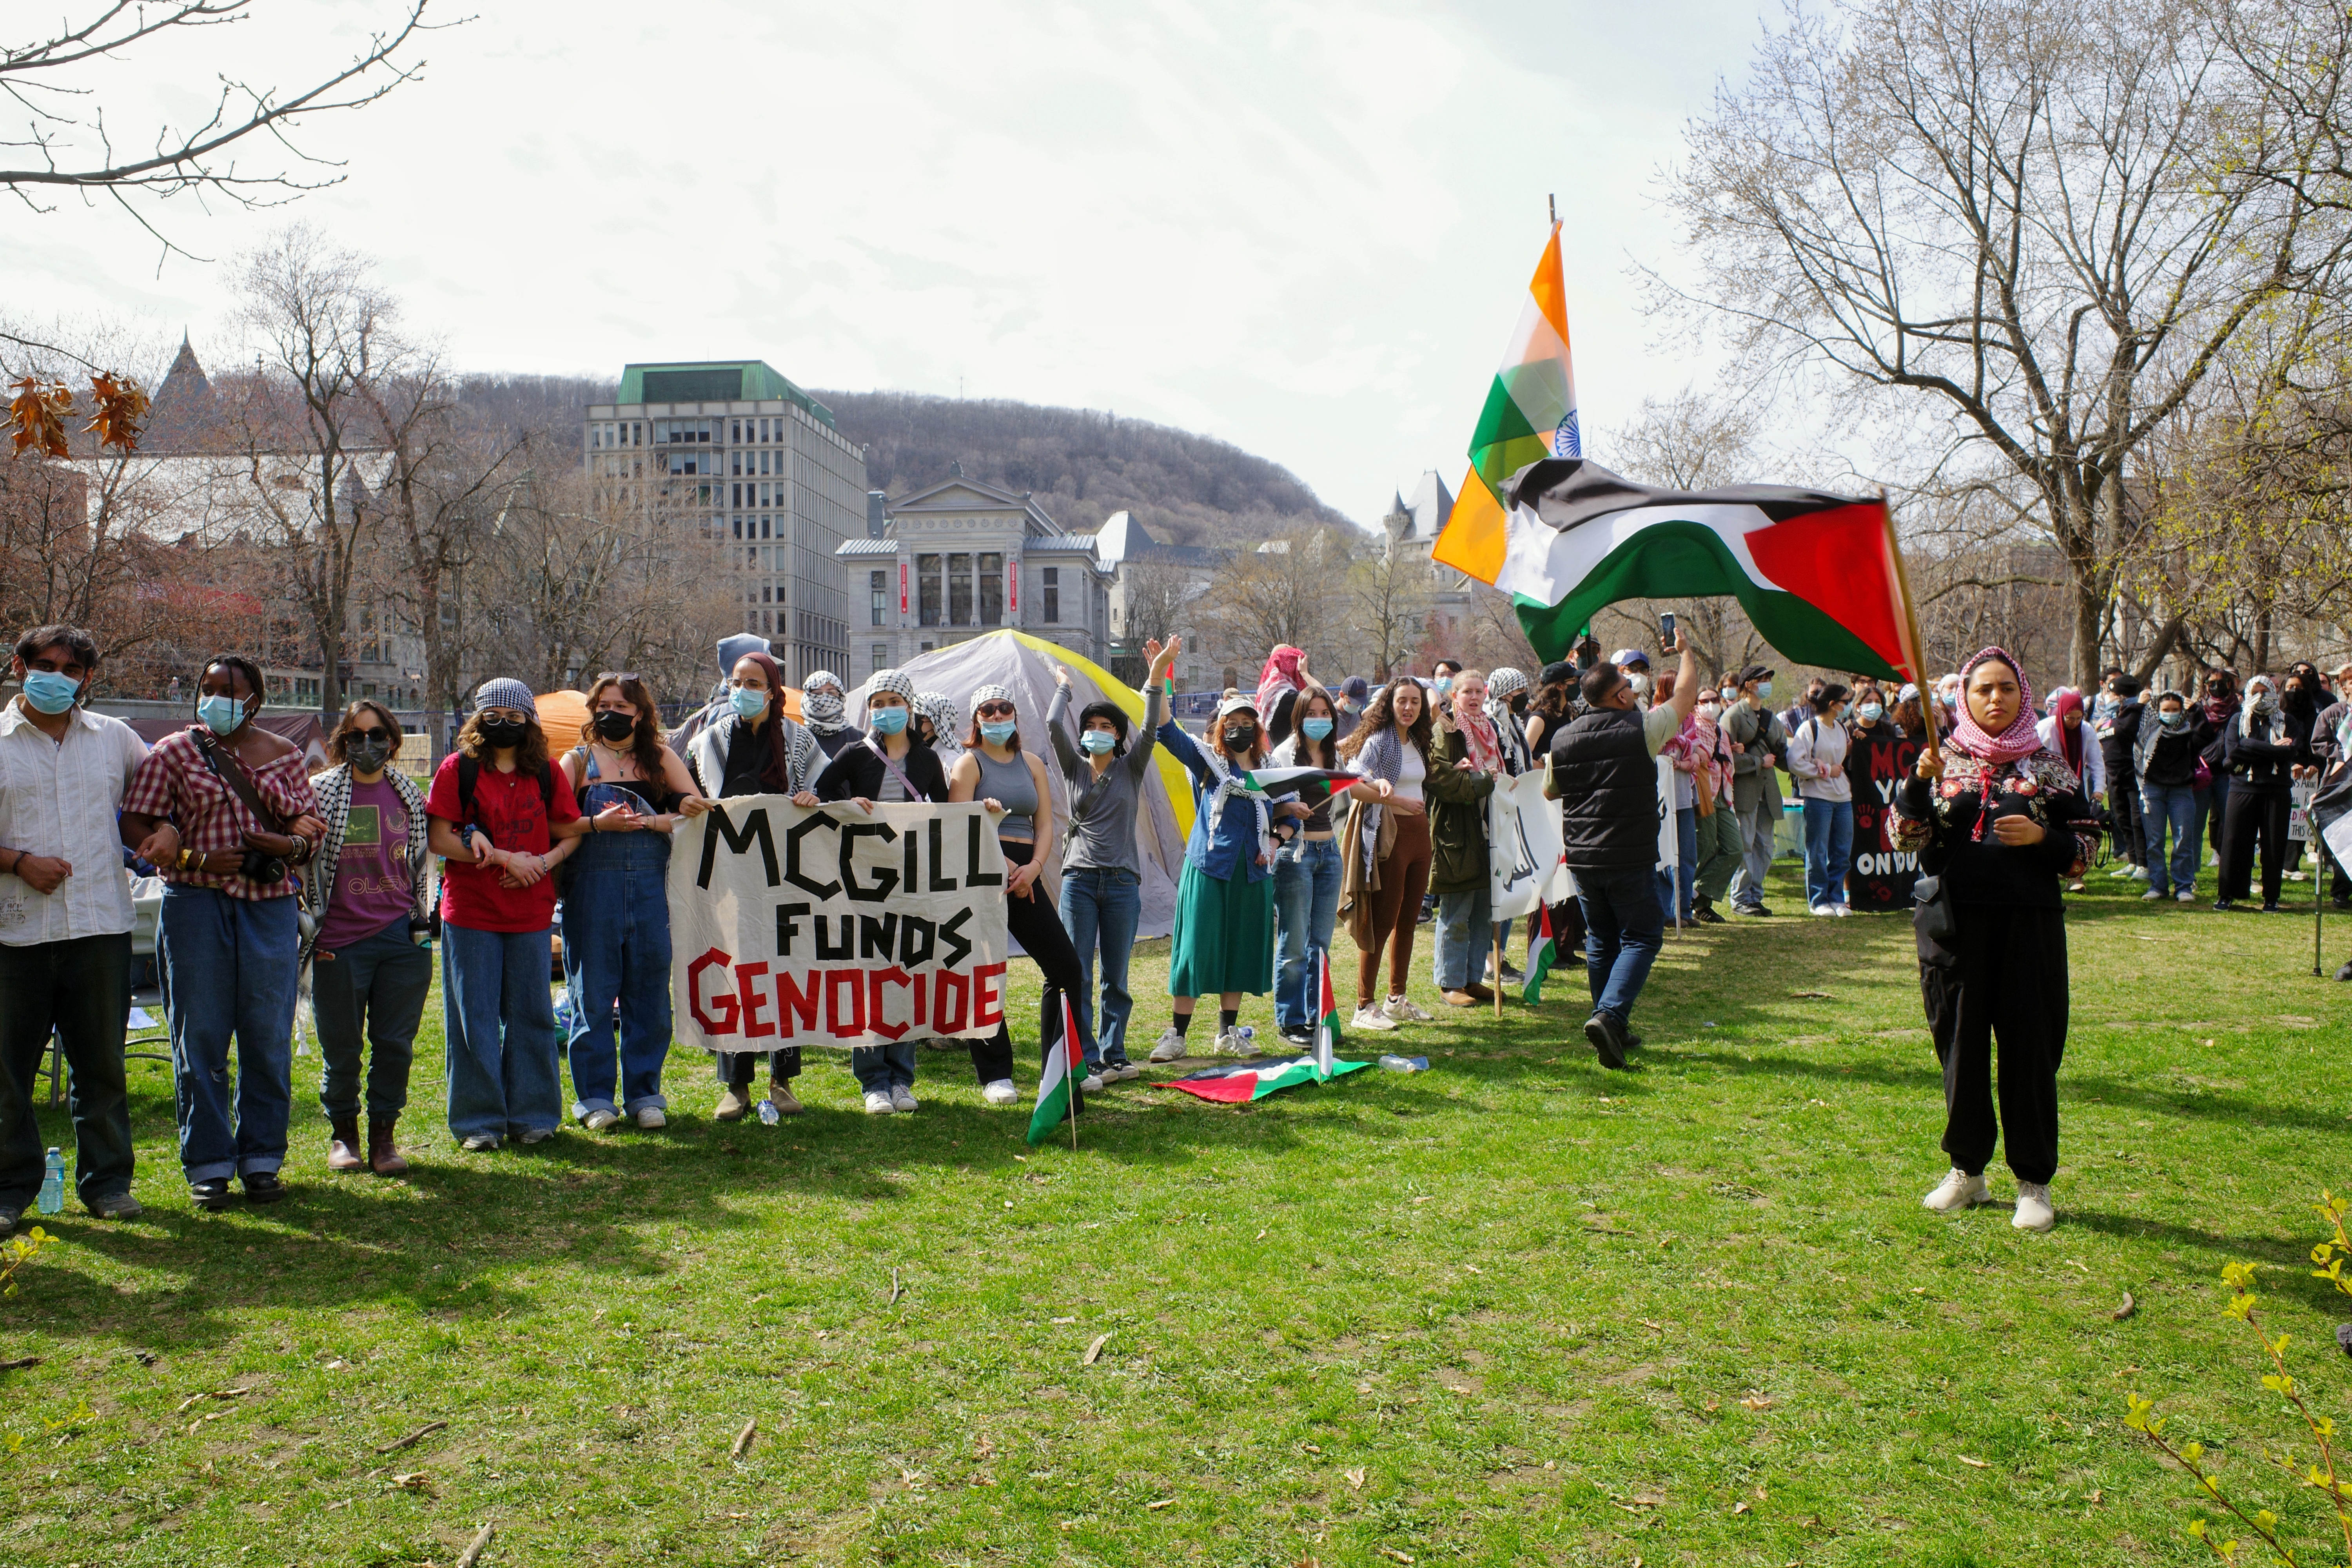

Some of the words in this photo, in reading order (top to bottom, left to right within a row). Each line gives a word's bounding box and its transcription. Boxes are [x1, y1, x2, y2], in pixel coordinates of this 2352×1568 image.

[1871, 741, 1929, 783] MC
[697, 804, 1002, 902] MCGILL
[2292, 825, 2305, 837] THIS
[1857, 852, 1891, 875] ON
[1893, 851, 1923, 873] YOU
[776, 902, 973, 970] FUNDS
[688, 947, 1006, 1040] GENOCIDE
